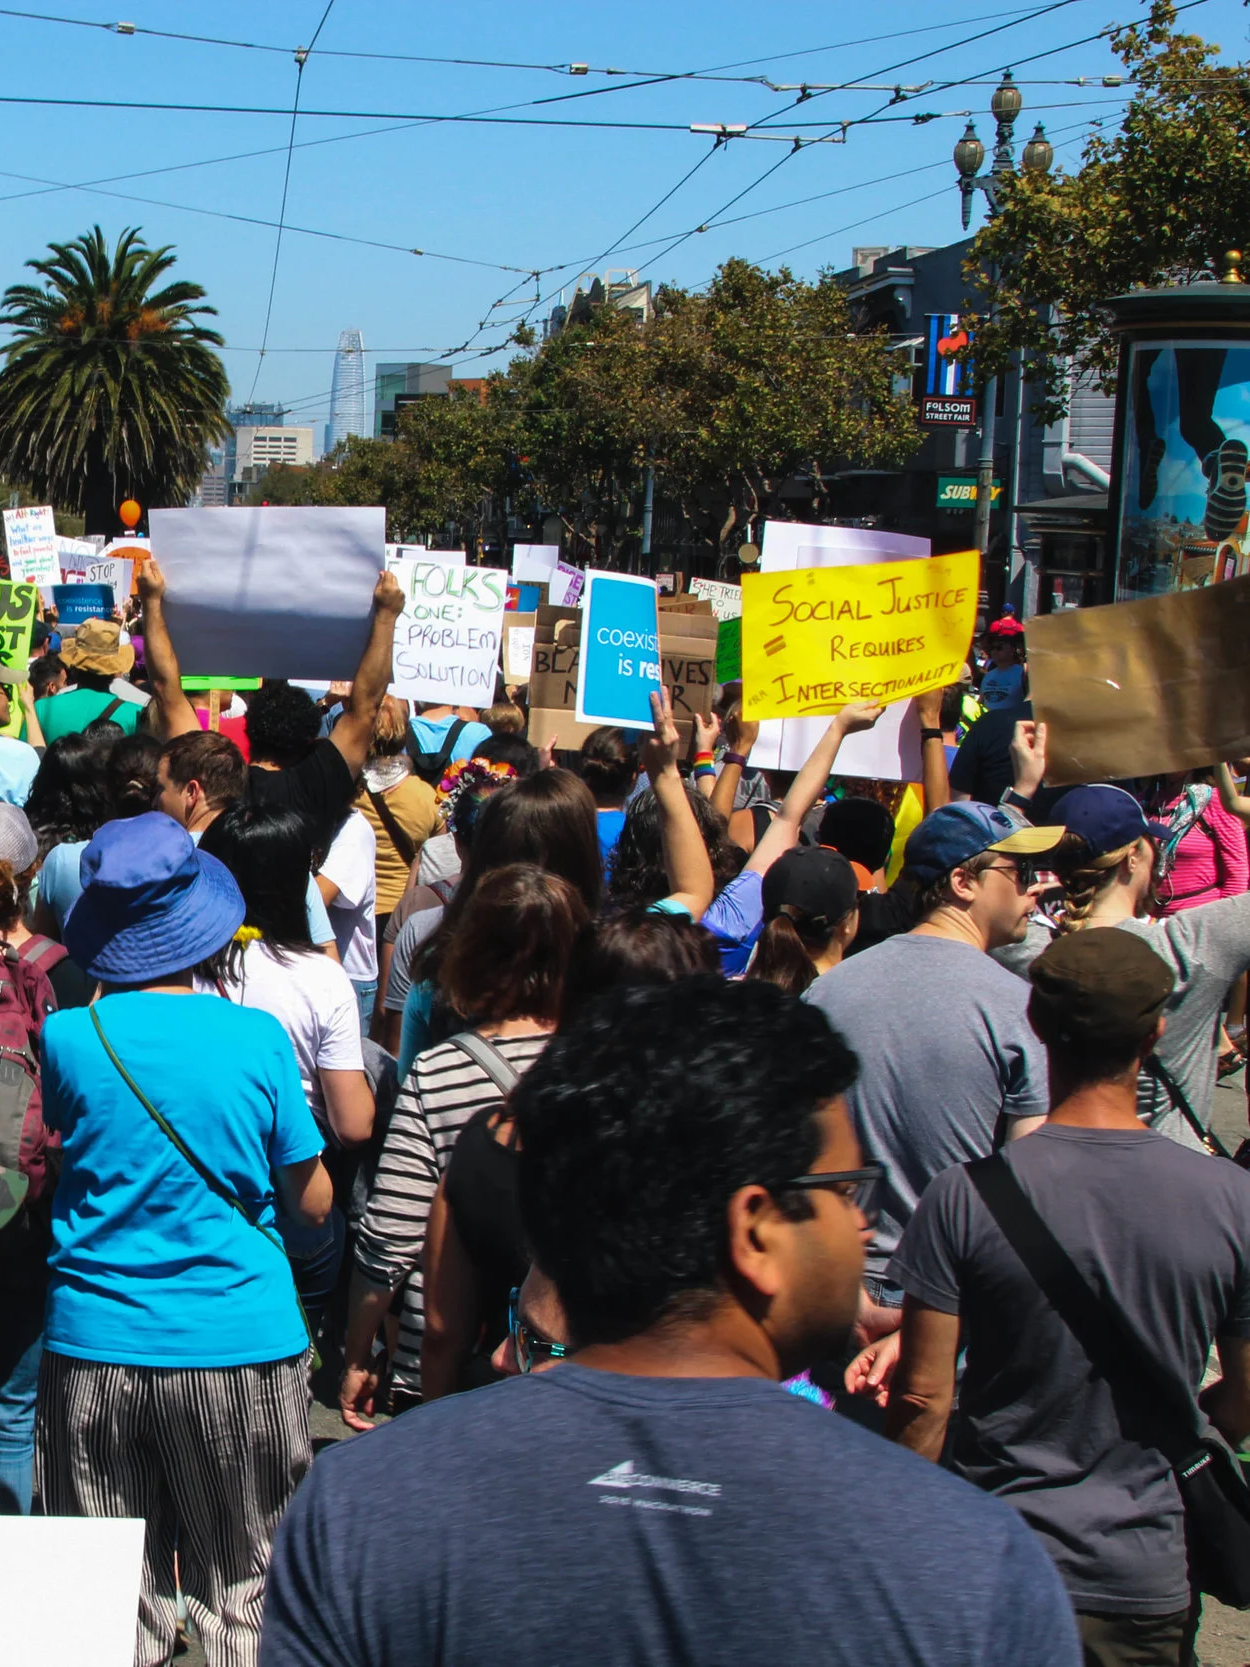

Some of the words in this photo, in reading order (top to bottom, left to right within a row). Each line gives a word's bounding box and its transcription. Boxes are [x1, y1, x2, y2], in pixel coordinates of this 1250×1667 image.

[925, 413, 952, 421] STREET
[954, 413, 970, 421] FAIR
[926, 402, 971, 413] FOLSOM
[940, 485, 1003, 500] SUBY
[90, 562, 115, 582] STOP
[411, 562, 504, 612] FOLKS
[693, 582, 716, 597] SHE
[66, 605, 73, 613] is
[769, 584, 872, 627] SOCIAL
[877, 576, 969, 615] JUSTICE
[414, 603, 463, 622] ONE:
[408, 624, 497, 650] PROBLEM
[830, 635, 925, 661] REQUIRES
[396, 651, 495, 689] SOLUTION
[618, 653, 633, 676] is
[772, 661, 959, 704] INTERSECTIONALITY
